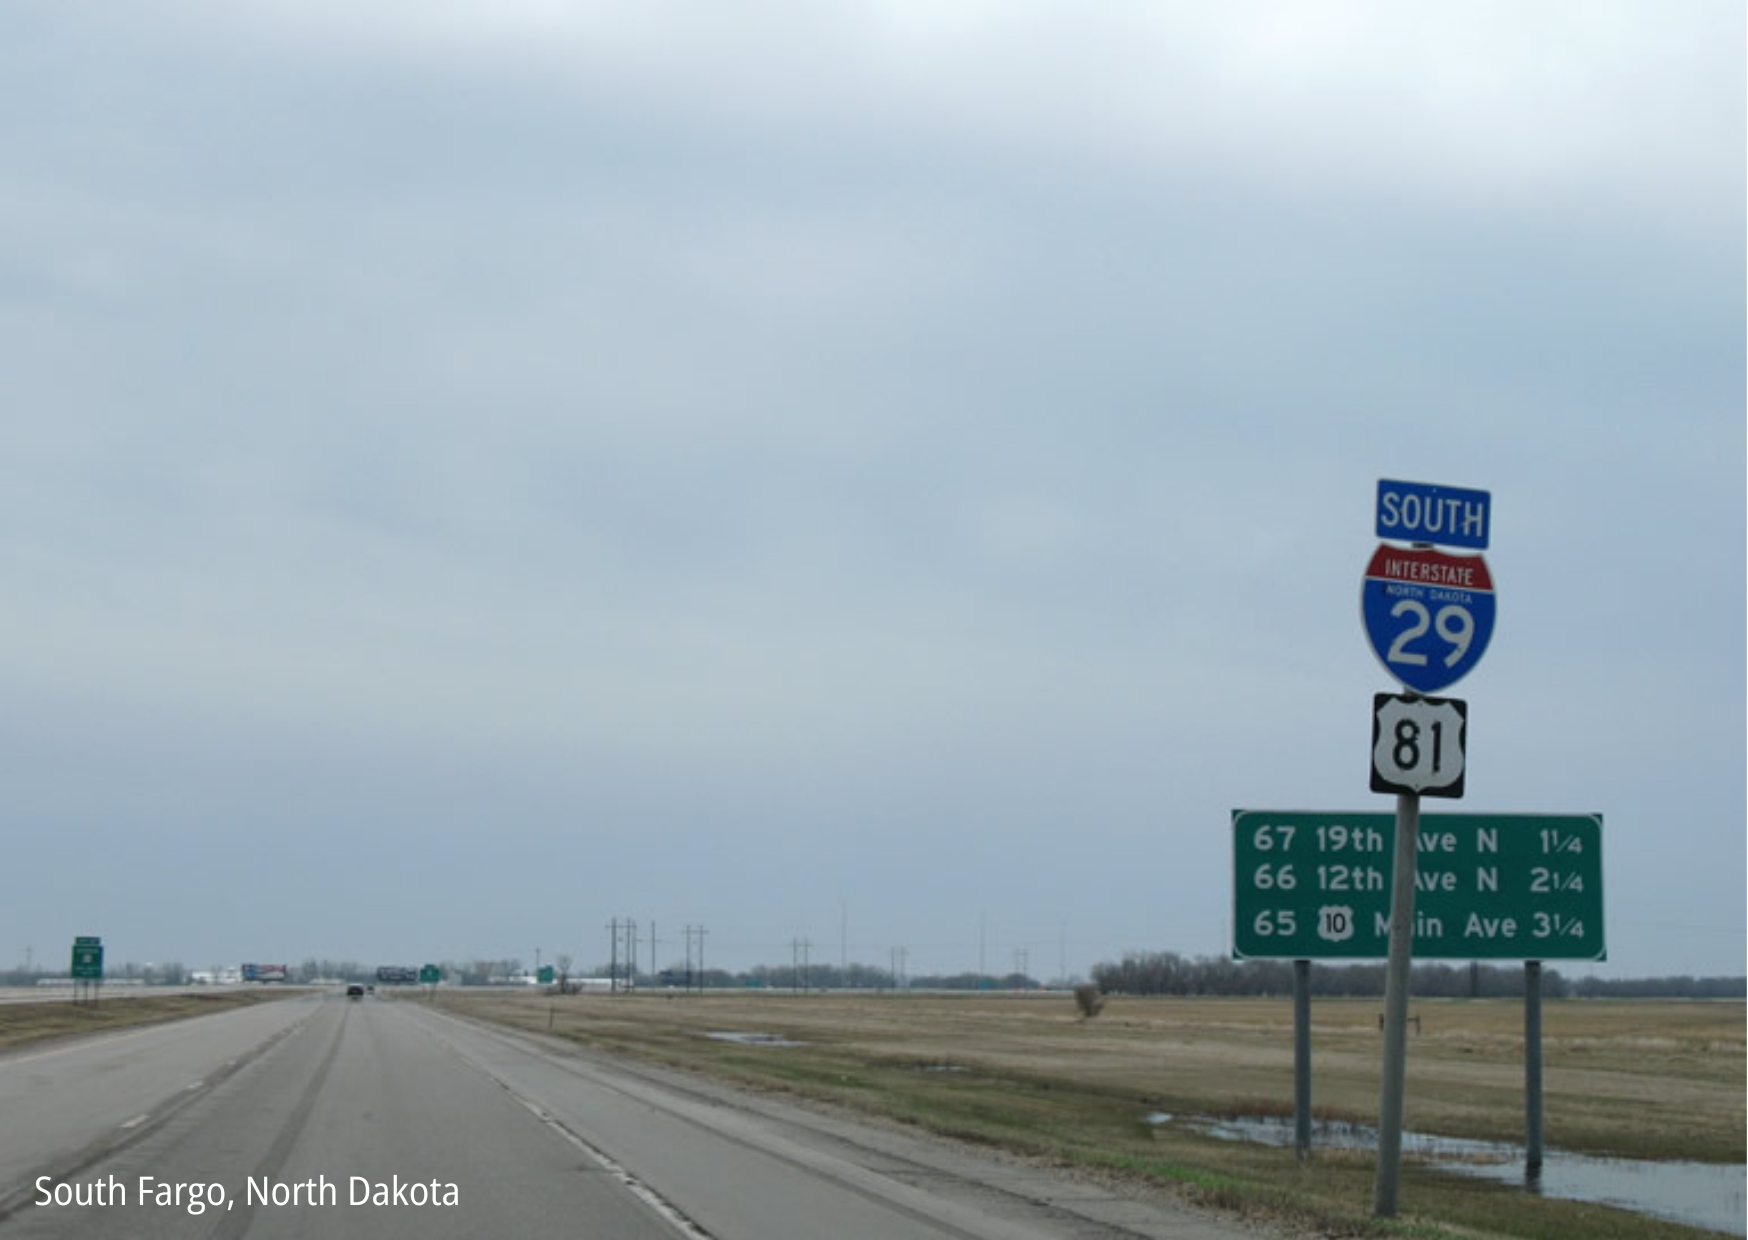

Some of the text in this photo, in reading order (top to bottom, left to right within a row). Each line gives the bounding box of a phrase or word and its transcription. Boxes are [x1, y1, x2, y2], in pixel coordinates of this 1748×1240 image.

[1381, 492, 1483, 537] SOUTH
[1385, 559, 1474, 586] INTERSTATE
[1386, 584, 1473, 604] NORTH DAKOTA
[1387, 600, 1475, 668] 29
[1393, 719, 1442, 773] 81
[1254, 826, 1296, 851] 67
[1316, 826, 1383, 852] 19th
[1477, 829, 1498, 852] N
[1254, 864, 1297, 890] 66
[1317, 865, 1384, 890] 12th
[1477, 868, 1498, 892] N
[1254, 911, 1297, 936] 65
[1325, 913, 1346, 933] 10
[1375, 912, 1443, 938] Min
[1465, 913, 1517, 938] Ave
